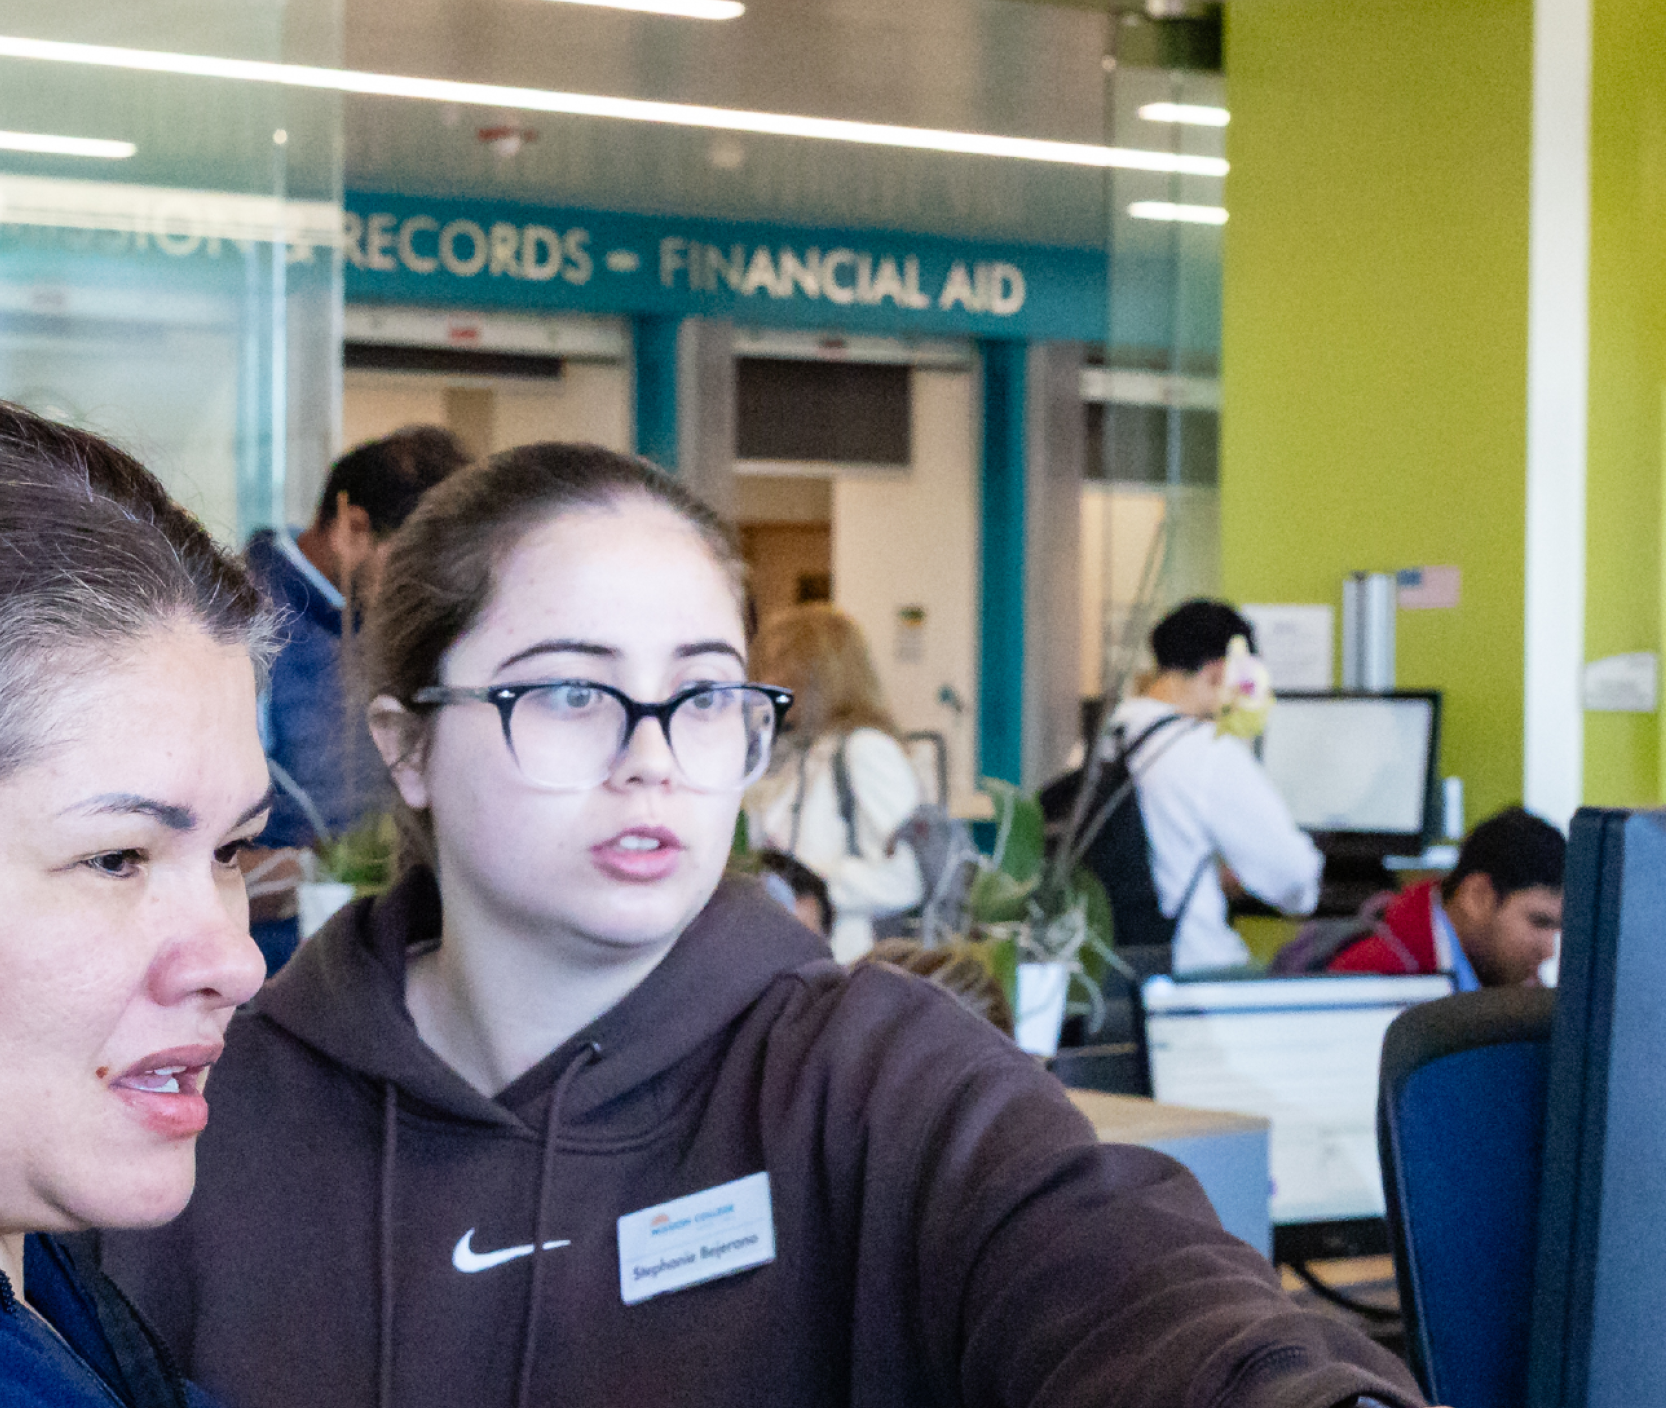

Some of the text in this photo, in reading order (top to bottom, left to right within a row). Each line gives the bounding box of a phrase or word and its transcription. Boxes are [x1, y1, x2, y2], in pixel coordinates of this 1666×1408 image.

[339, 209, 593, 286] RECORDS
[657, 234, 931, 310] FINANCIAL
[939, 258, 1028, 318] AID
